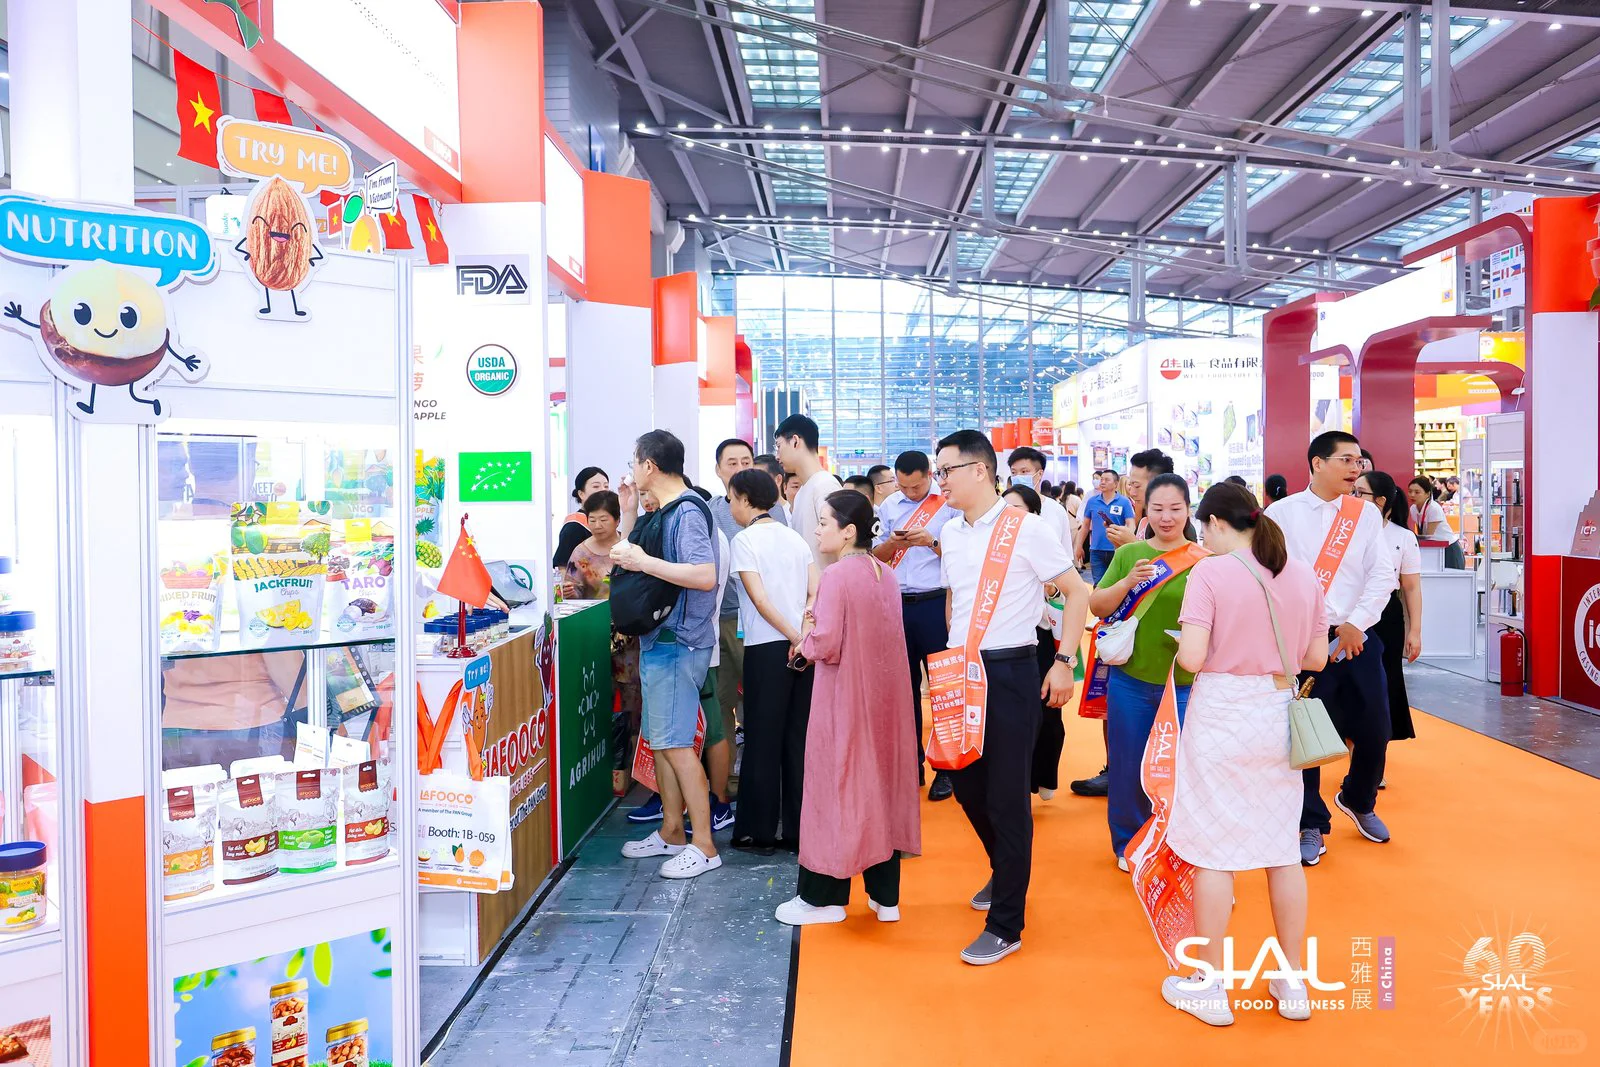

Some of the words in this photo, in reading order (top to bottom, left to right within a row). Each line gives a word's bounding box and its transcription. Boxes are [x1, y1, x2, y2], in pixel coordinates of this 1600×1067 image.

[233, 135, 286, 168] TRY
[297, 145, 338, 178] ME!
[369, 179, 378, 190] I'm
[378, 176, 392, 188] from
[370, 191, 392, 204] Vietnam
[6, 210, 197, 261] NUTRITION
[456, 264, 528, 295] FDA
[477, 357, 506, 368] USDA
[1184, 357, 1262, 369] 味一食品有限
[474, 371, 510, 382] ORGANIC
[414, 399, 437, 408] NGO
[414, 411, 446, 420] APPLE
[996, 516, 1019, 551] SIAL
[1332, 517, 1354, 548] SIAL
[1580, 525, 1597, 535] ICP
[254, 578, 313, 593] JACKFRUIT
[341, 575, 386, 590] TARO
[192, 591, 217, 603] FRUIT
[977, 579, 999, 617] SIAL
[1579, 650, 1599, 682] CASING
[467, 668, 478, 682] Try
[1155, 721, 1173, 765] SIAL
[569, 738, 606, 789] AGRIHUB
[420, 789, 473, 804] LAFOOCO
[428, 826, 460, 839] Booth:
[462, 829, 496, 844] 1B-059
